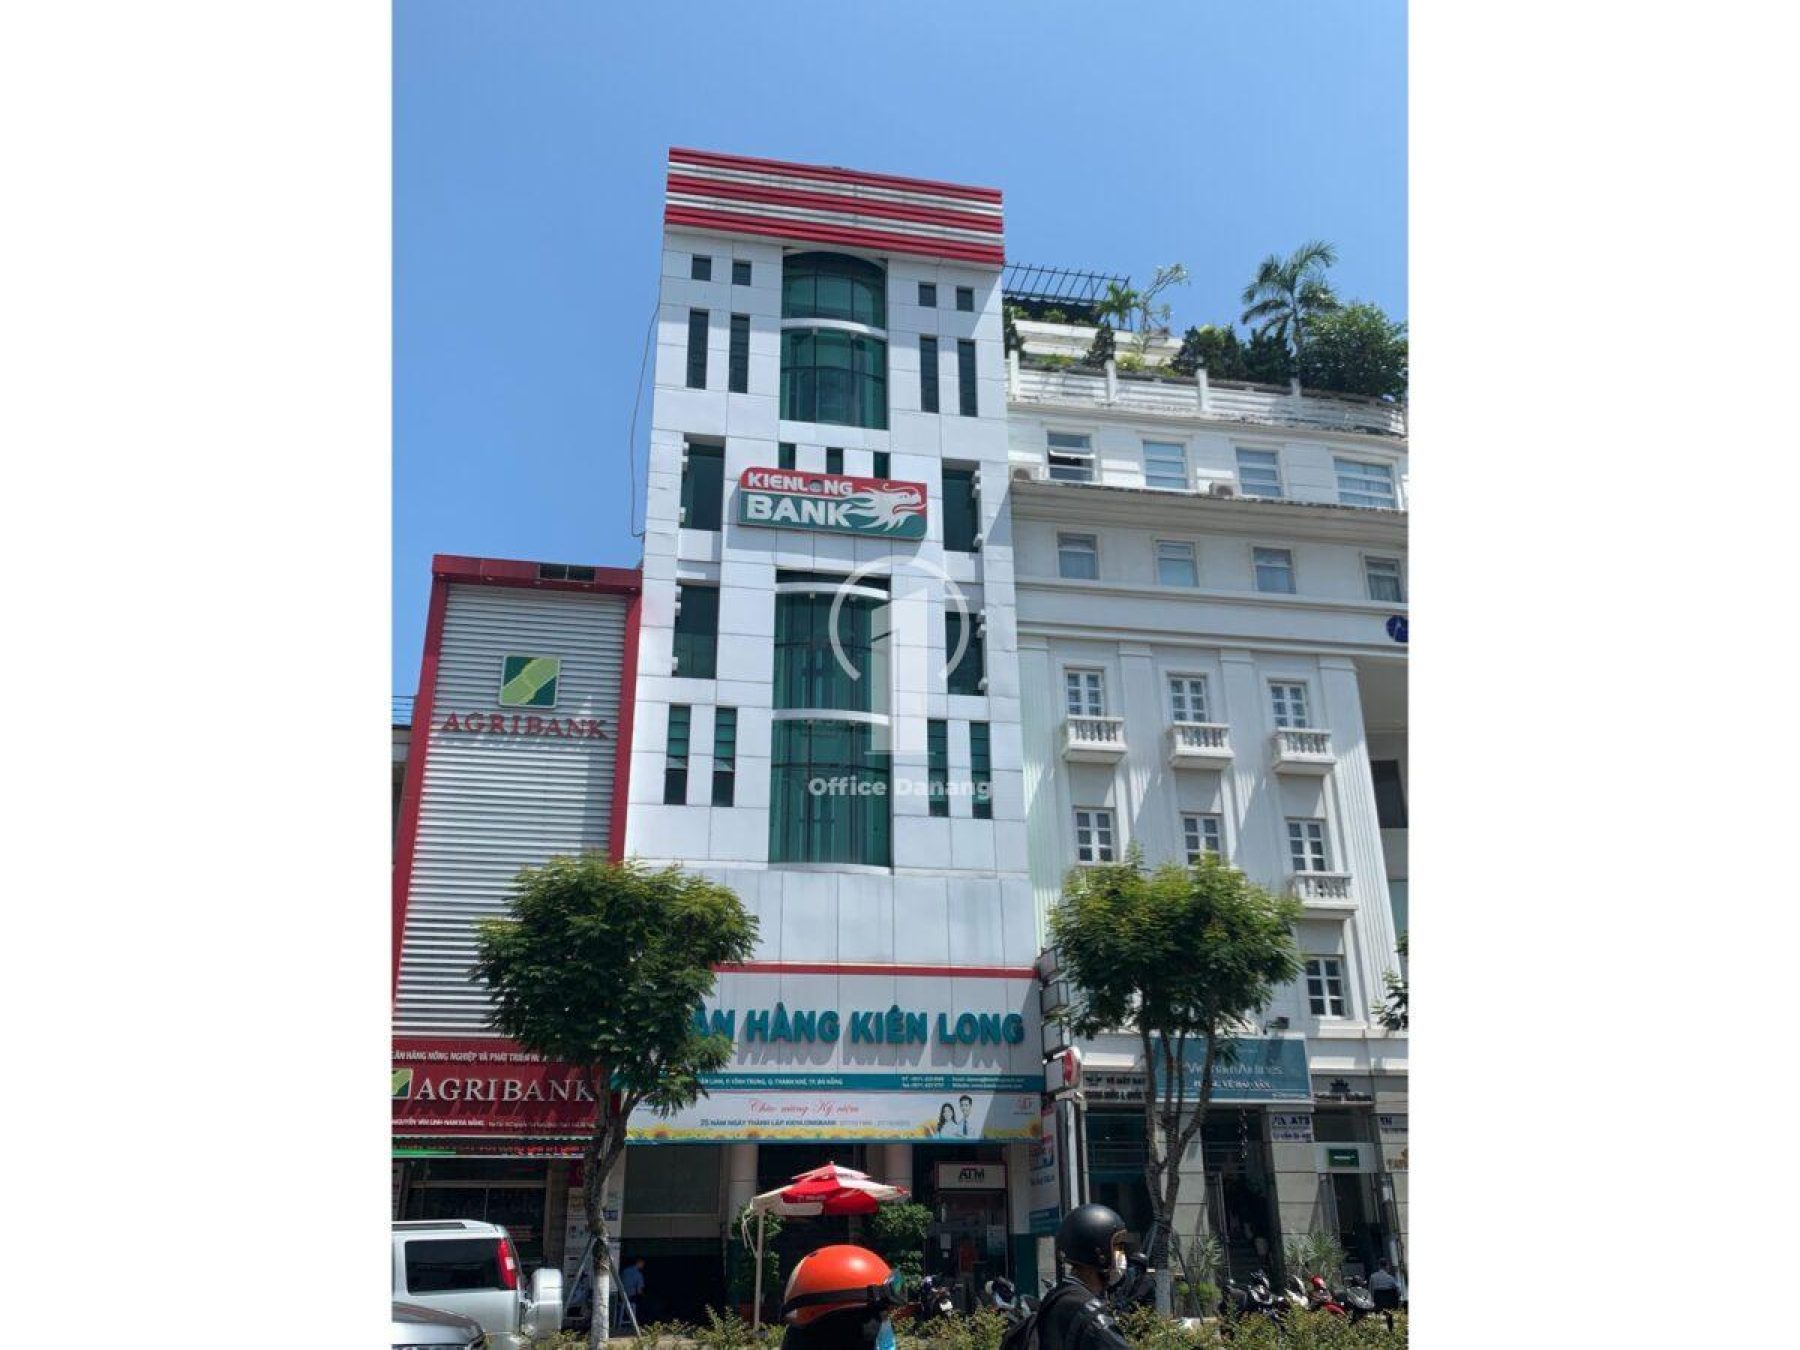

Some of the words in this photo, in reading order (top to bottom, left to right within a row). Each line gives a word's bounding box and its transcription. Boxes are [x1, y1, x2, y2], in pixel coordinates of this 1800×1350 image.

[746, 494, 852, 528] BANK
[442, 712, 608, 740] AGRIBANK
[690, 1000, 735, 1041] ÂN
[746, 1001, 841, 1044] HÀNG
[851, 1004, 928, 1045] KIÊN
[938, 1011, 1025, 1046] LONG
[415, 1077, 596, 1102] AGRIBANK
[959, 1167, 985, 1180] ATM
